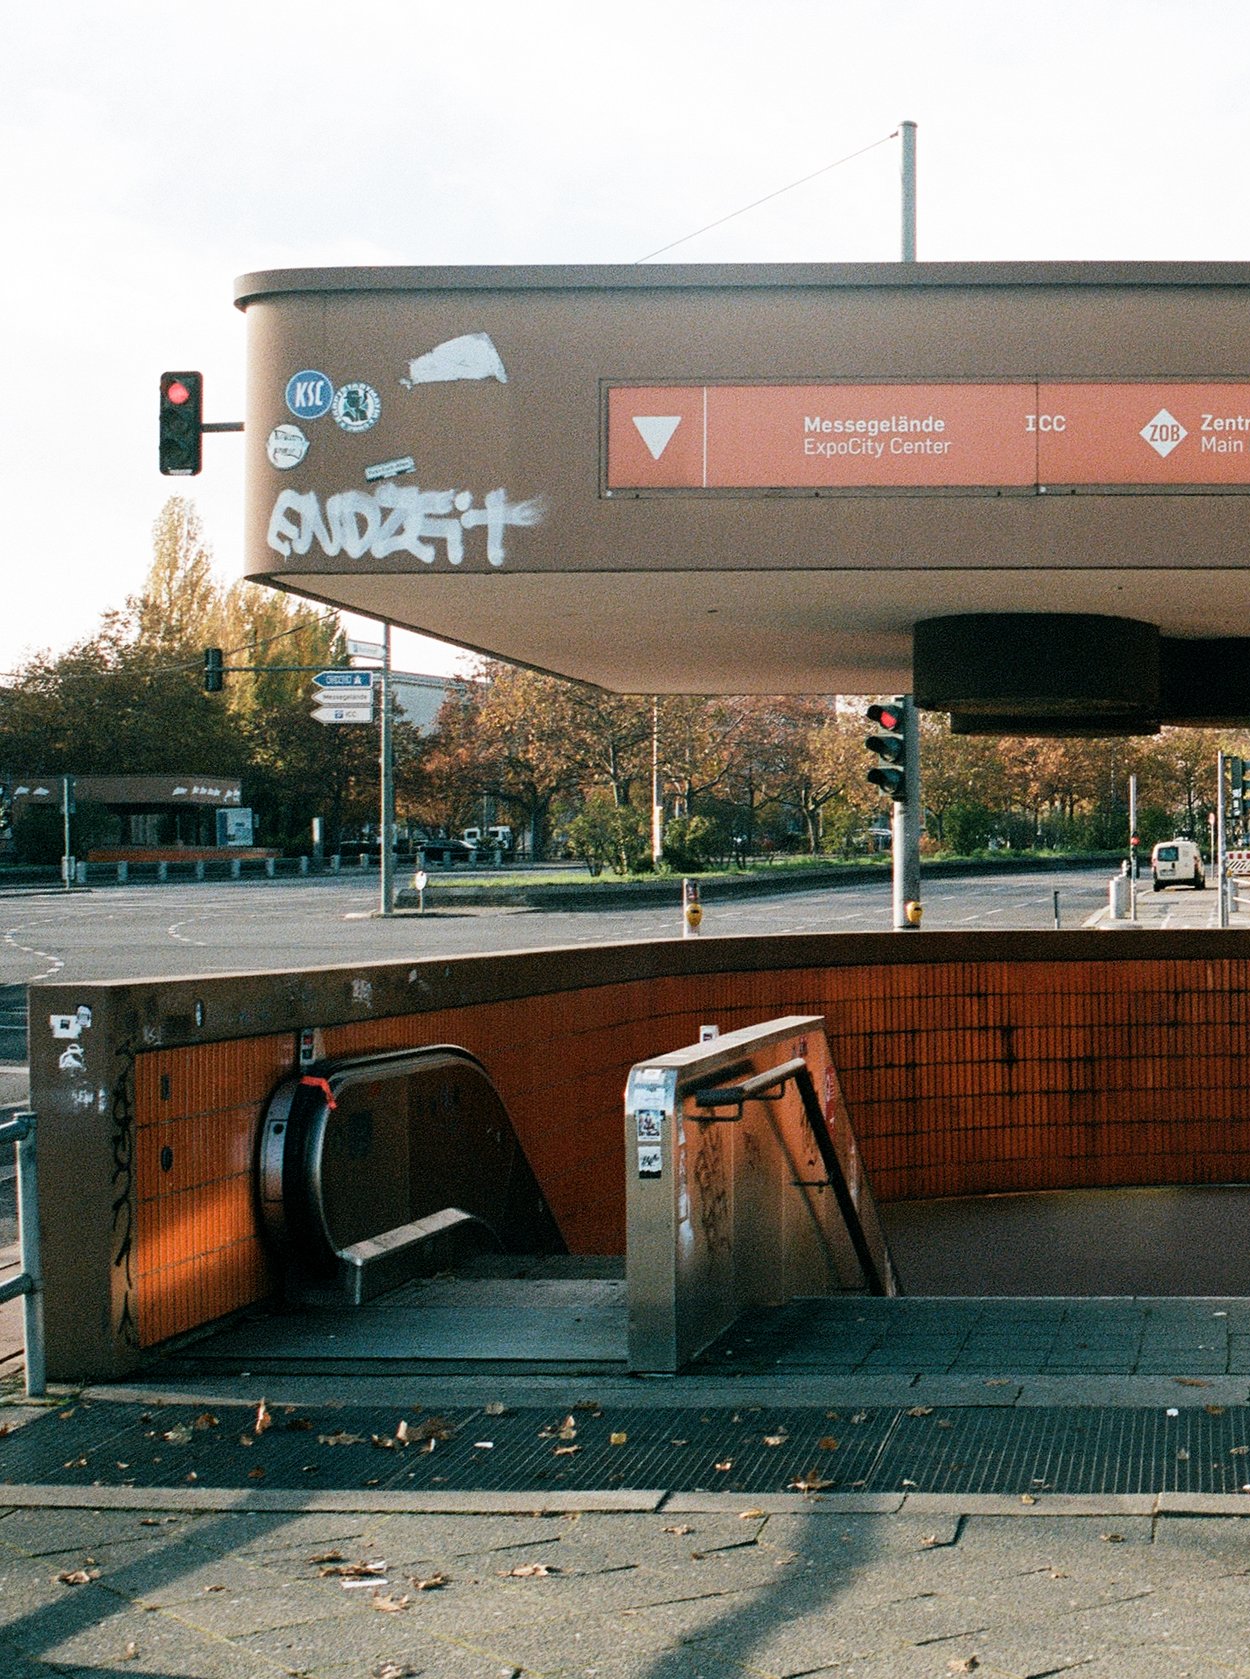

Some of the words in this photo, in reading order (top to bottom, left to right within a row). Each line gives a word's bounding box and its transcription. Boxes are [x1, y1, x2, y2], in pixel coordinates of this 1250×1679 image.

[294, 380, 324, 408] KSC
[803, 416, 945, 436] Messegelände
[1025, 415, 1066, 432] ICC
[1149, 423, 1181, 442] ZOB
[804, 438, 884, 458] ExpoCity
[890, 438, 951, 455] Center
[1201, 436, 1244, 453] Main
